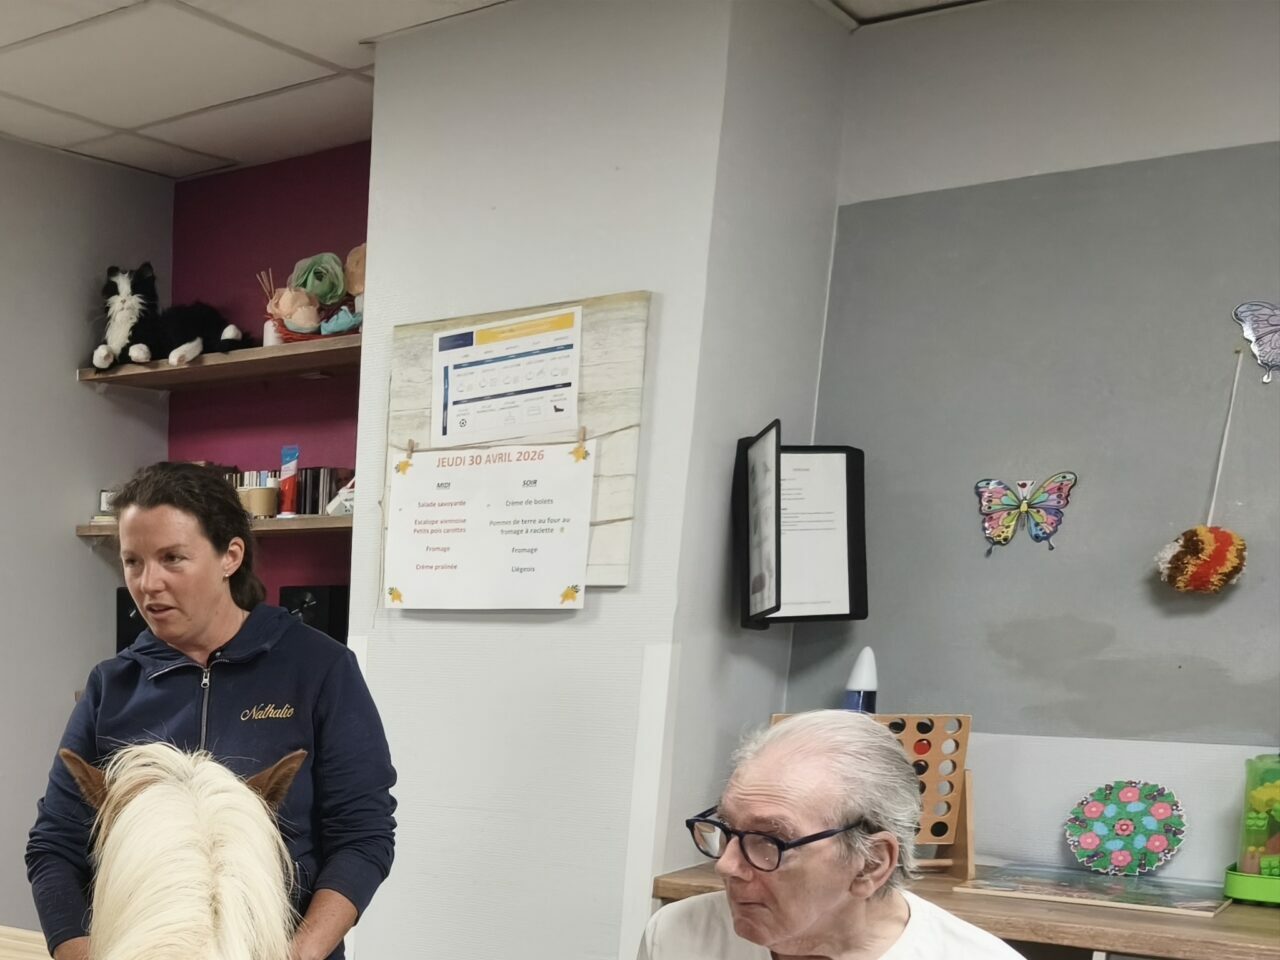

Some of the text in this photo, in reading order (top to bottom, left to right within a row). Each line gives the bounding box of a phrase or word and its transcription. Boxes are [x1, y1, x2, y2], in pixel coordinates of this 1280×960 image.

[437, 450, 544, 467] JEUDI 30 AVRIL 2026
